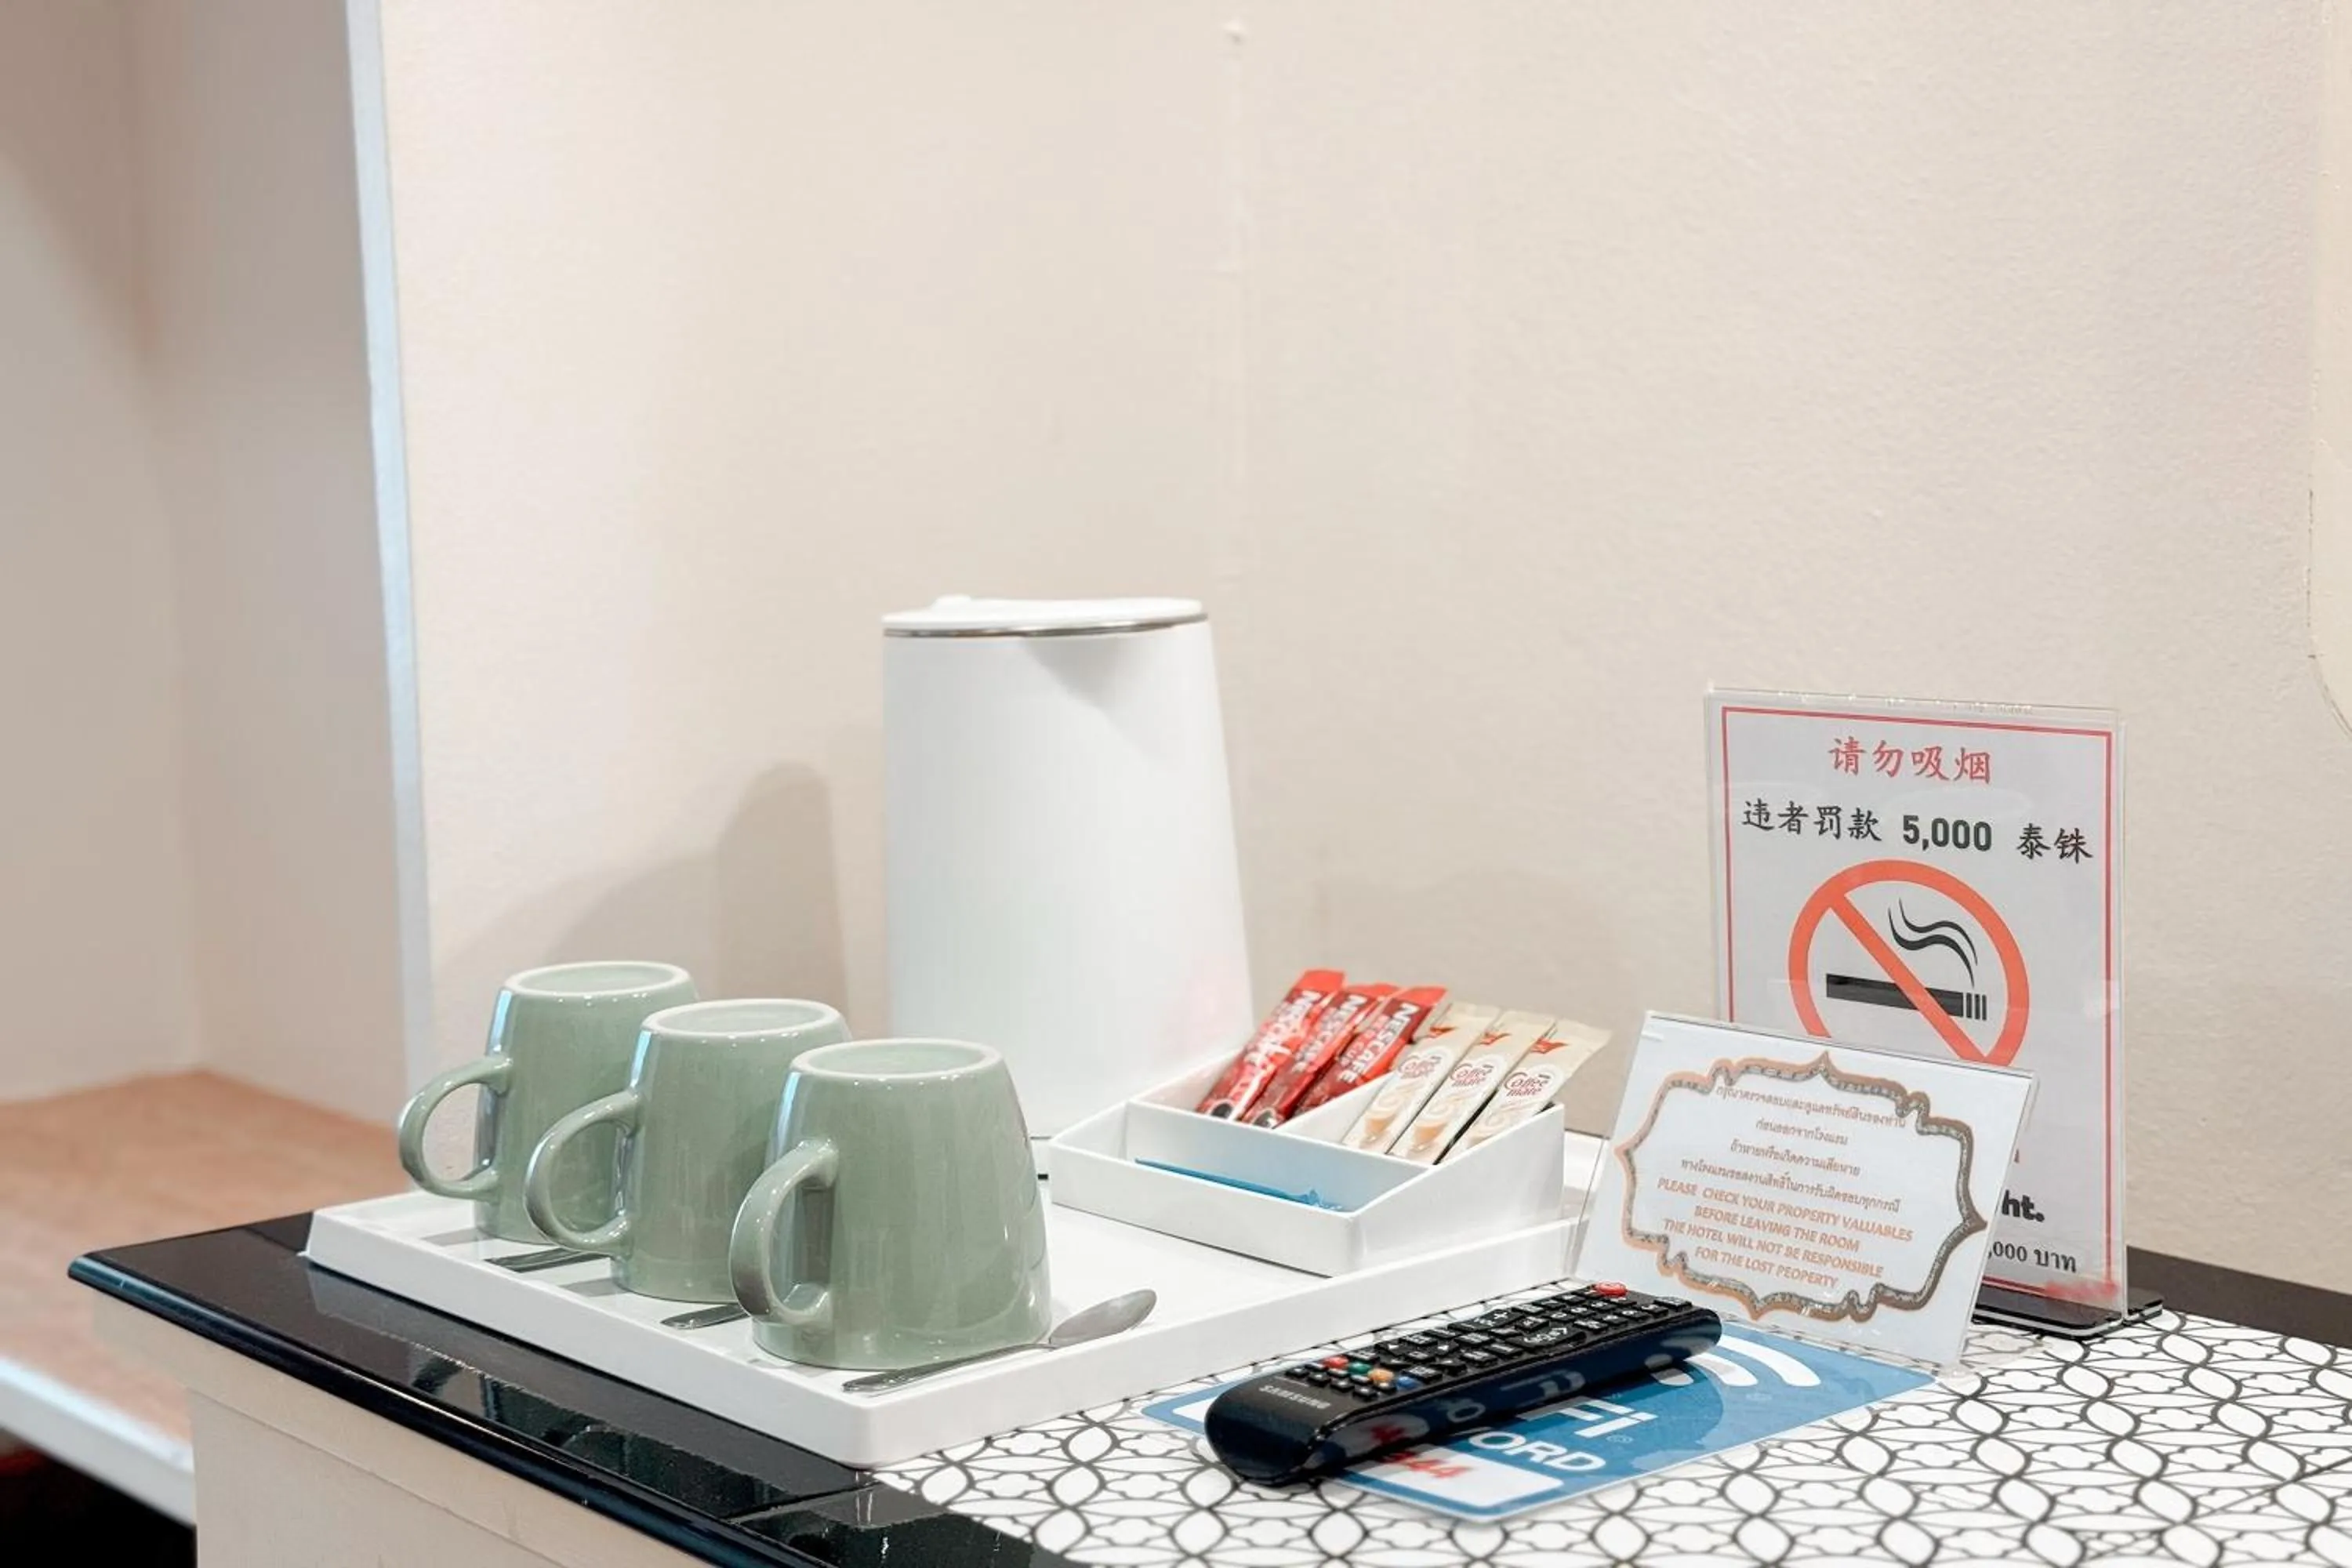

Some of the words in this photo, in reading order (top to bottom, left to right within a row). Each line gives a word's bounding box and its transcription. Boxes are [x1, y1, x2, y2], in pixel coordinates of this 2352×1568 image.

[1828, 735, 1991, 784] 请勿吸烟
[1741, 798, 1882, 841] 违者罚款
[1902, 815, 1992, 851] 5,000
[2016, 822, 2093, 863] 泰铢
[1657, 1178, 1698, 1197] PLEASE
[1702, 1187, 1740, 1205] CHECK
[1742, 1196, 1777, 1214] YOUR
[1777, 1201, 1842, 1226] PROPERTY
[1842, 1216, 1914, 1242] VALUABLES
[1694, 1205, 1740, 1225] BEFORE
[1740, 1216, 1791, 1236] LEAVING
[1793, 1226, 1818, 1242] THE
[1819, 1232, 1861, 1252] ROOM
[1664, 1218, 1686, 1234] THE
[1686, 1223, 1723, 1242] HOTEL
[1726, 1232, 1754, 1248] WILL
[1755, 1239, 1784, 1255] NOT
[1785, 1246, 1802, 1259] BE
[1802, 1250, 1884, 1278] RESPONSIBLE
[1694, 1246, 1722, 1261] FOR
[1723, 1251, 1746, 1268] THE
[1745, 1257, 1775, 1276] LOST
[1776, 1264, 1838, 1289] PEOPERTY
[2034, 1248, 2077, 1273] บาท
[1258, 1385, 1330, 1410] SAMSUNG
[1468, 1430, 1606, 1472] ORD
